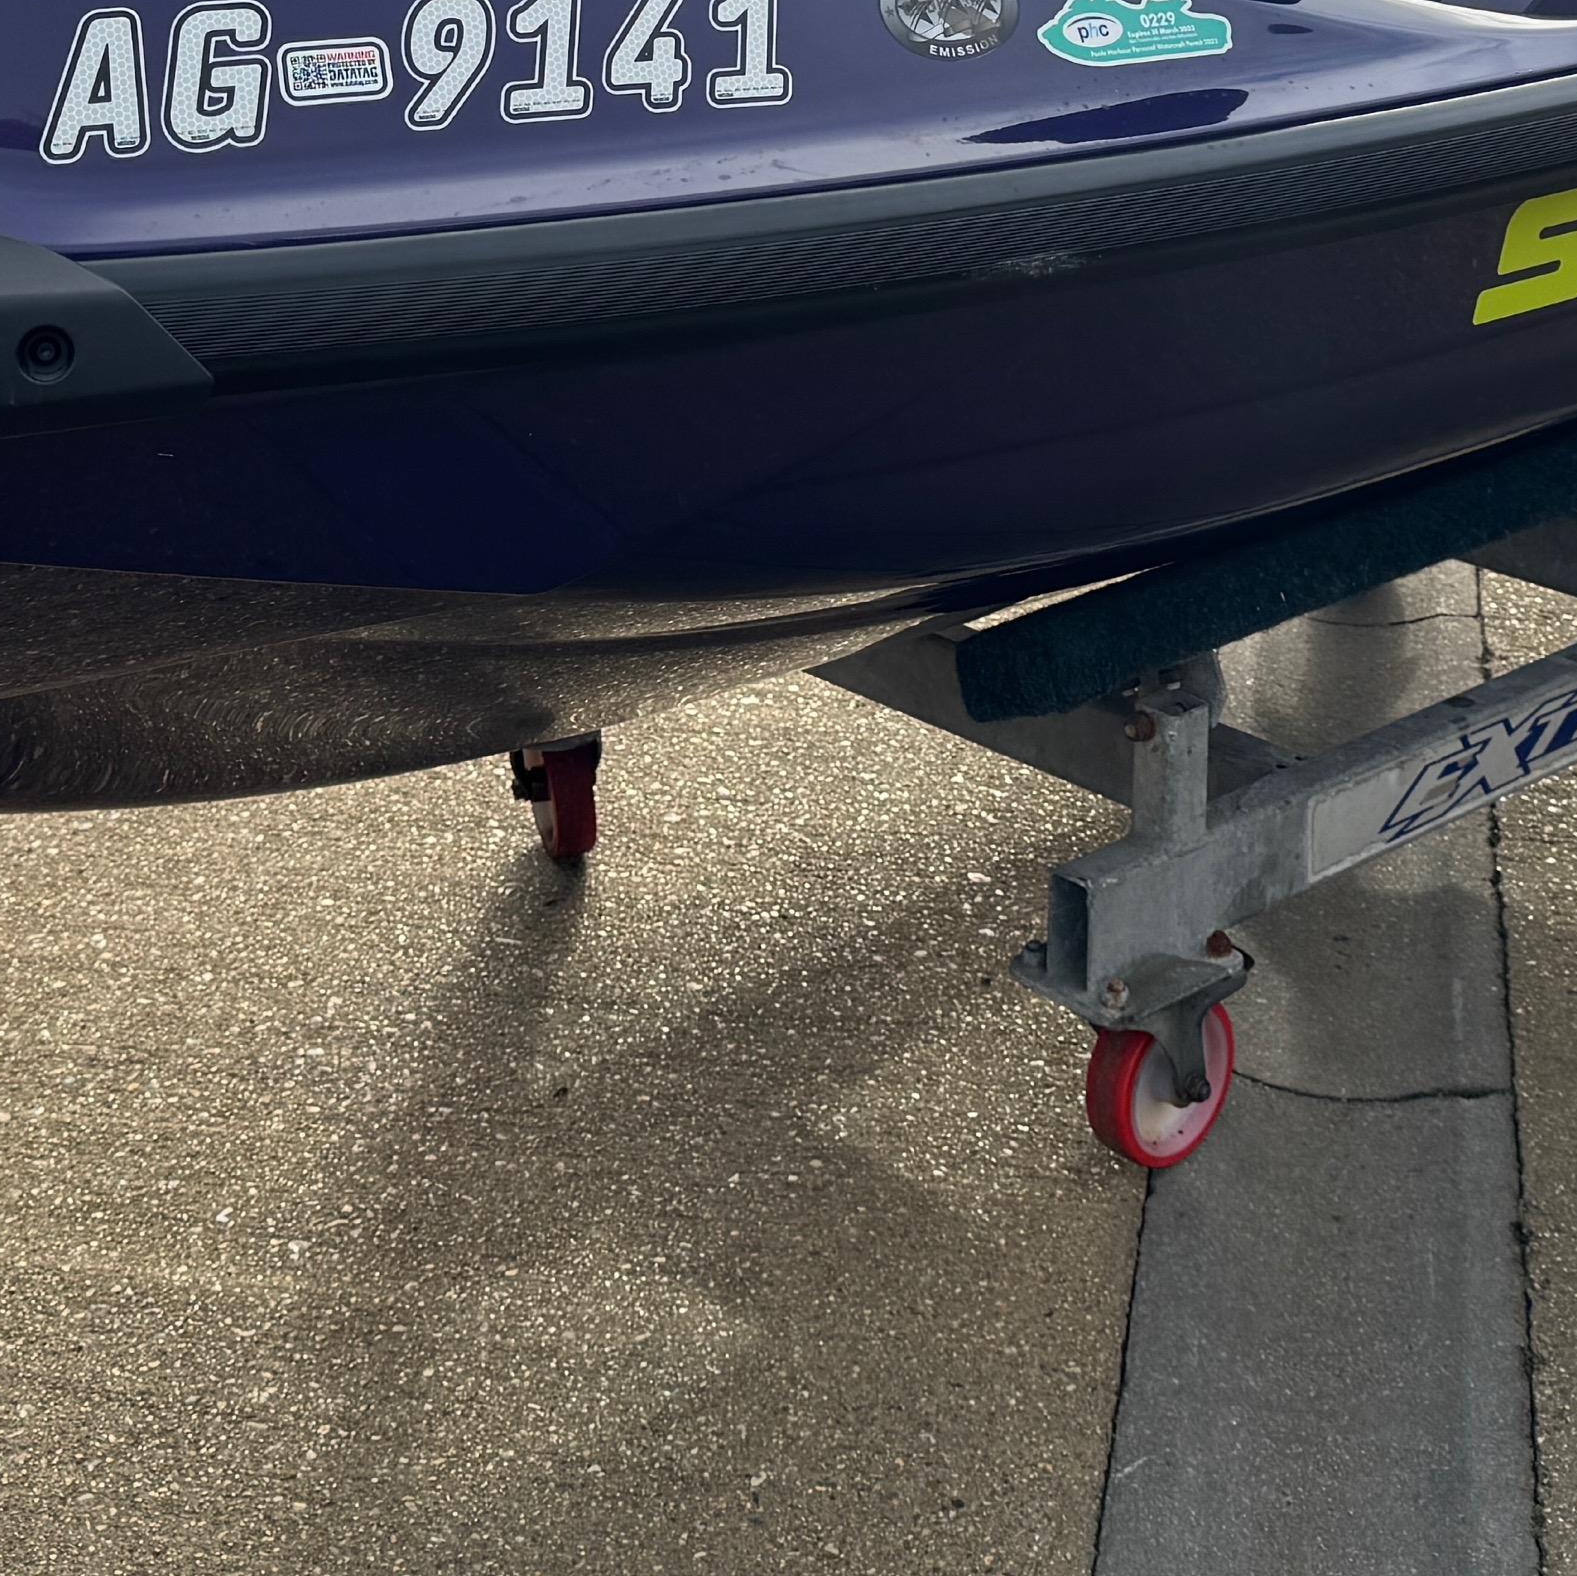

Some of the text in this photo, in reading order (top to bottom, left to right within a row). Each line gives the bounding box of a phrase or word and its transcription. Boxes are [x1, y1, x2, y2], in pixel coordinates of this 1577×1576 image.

[1140, 11, 1175, 28] 0229
[1077, 23, 1109, 43] phc
[929, 35, 999, 57] EMISSION
[327, 50, 375, 62] WARNING
[328, 67, 378, 81] DATATAG
